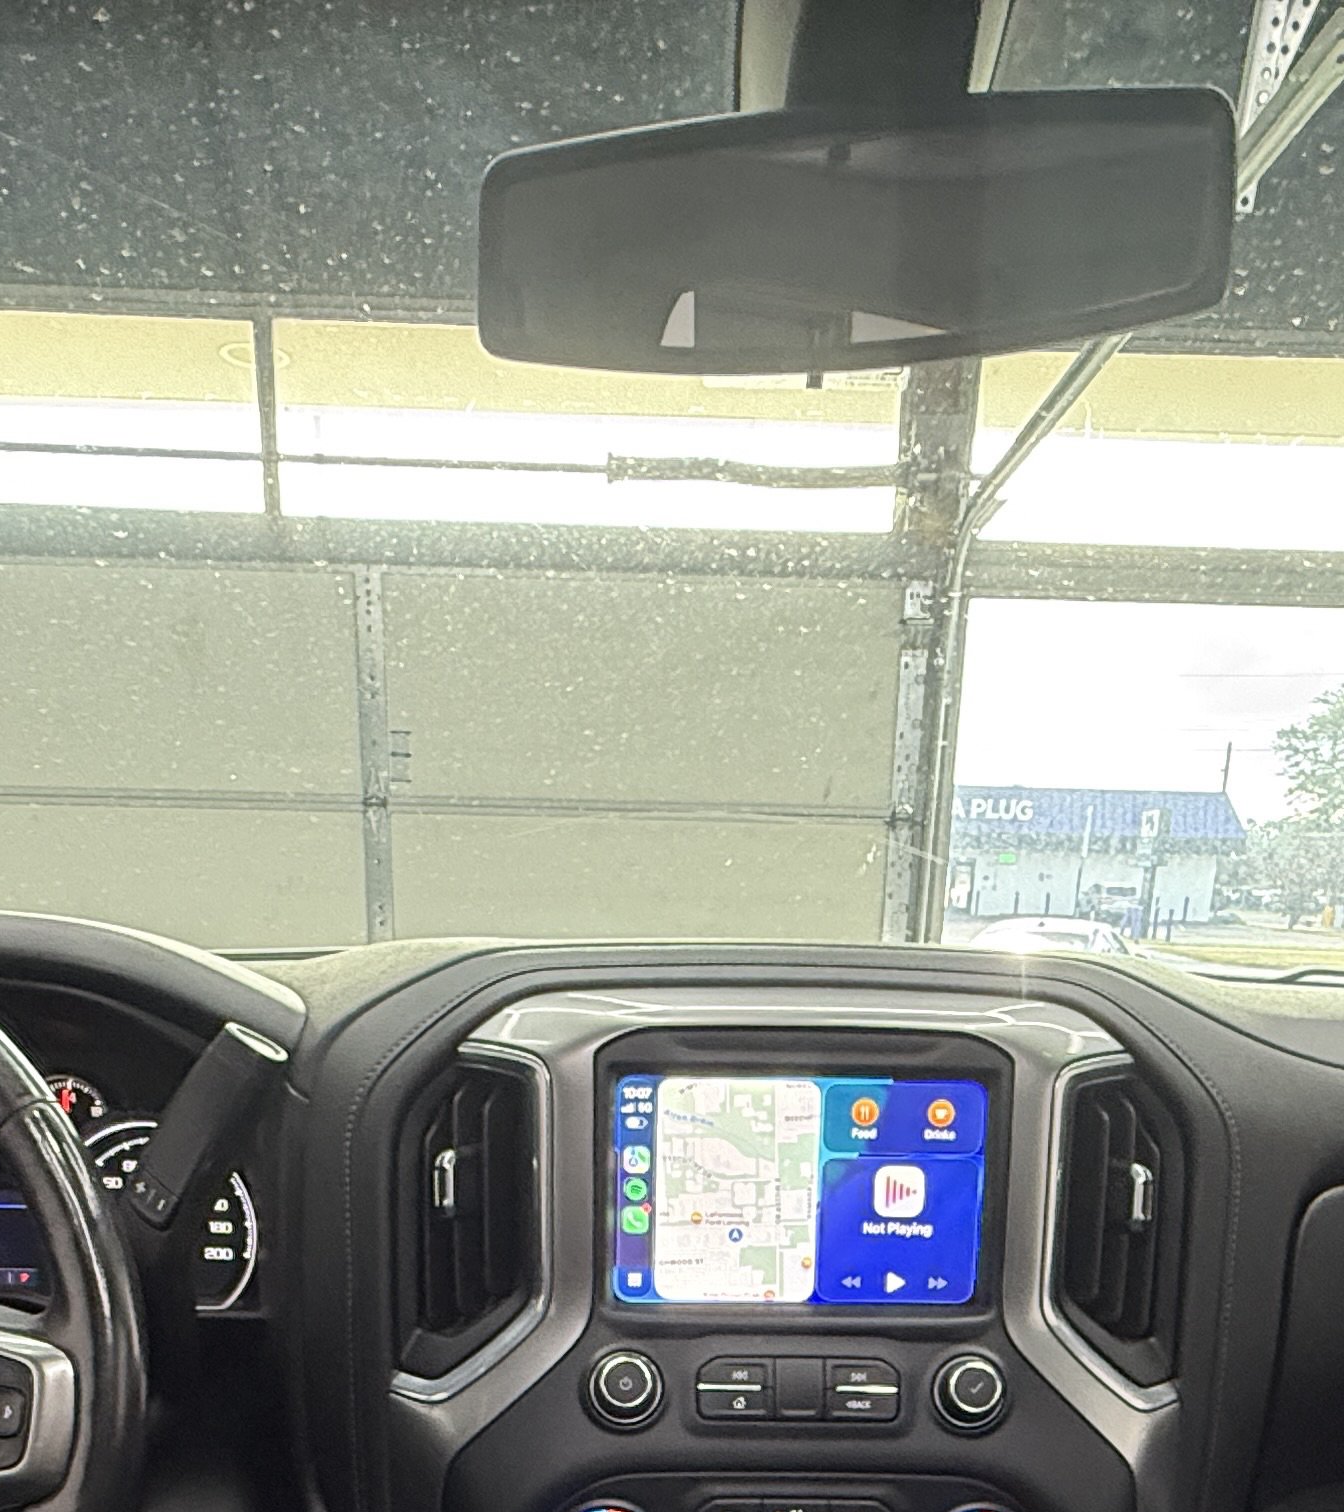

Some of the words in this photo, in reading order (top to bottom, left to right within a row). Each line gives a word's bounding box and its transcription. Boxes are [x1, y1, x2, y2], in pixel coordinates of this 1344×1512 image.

[970, 798, 1034, 821] PLUG
[851, 1128, 878, 1139] Food
[208, 1221, 233, 1234] 180
[863, 1222, 885, 1235] Not
[887, 1222, 934, 1238] Playing
[204, 1248, 234, 1260] 200
